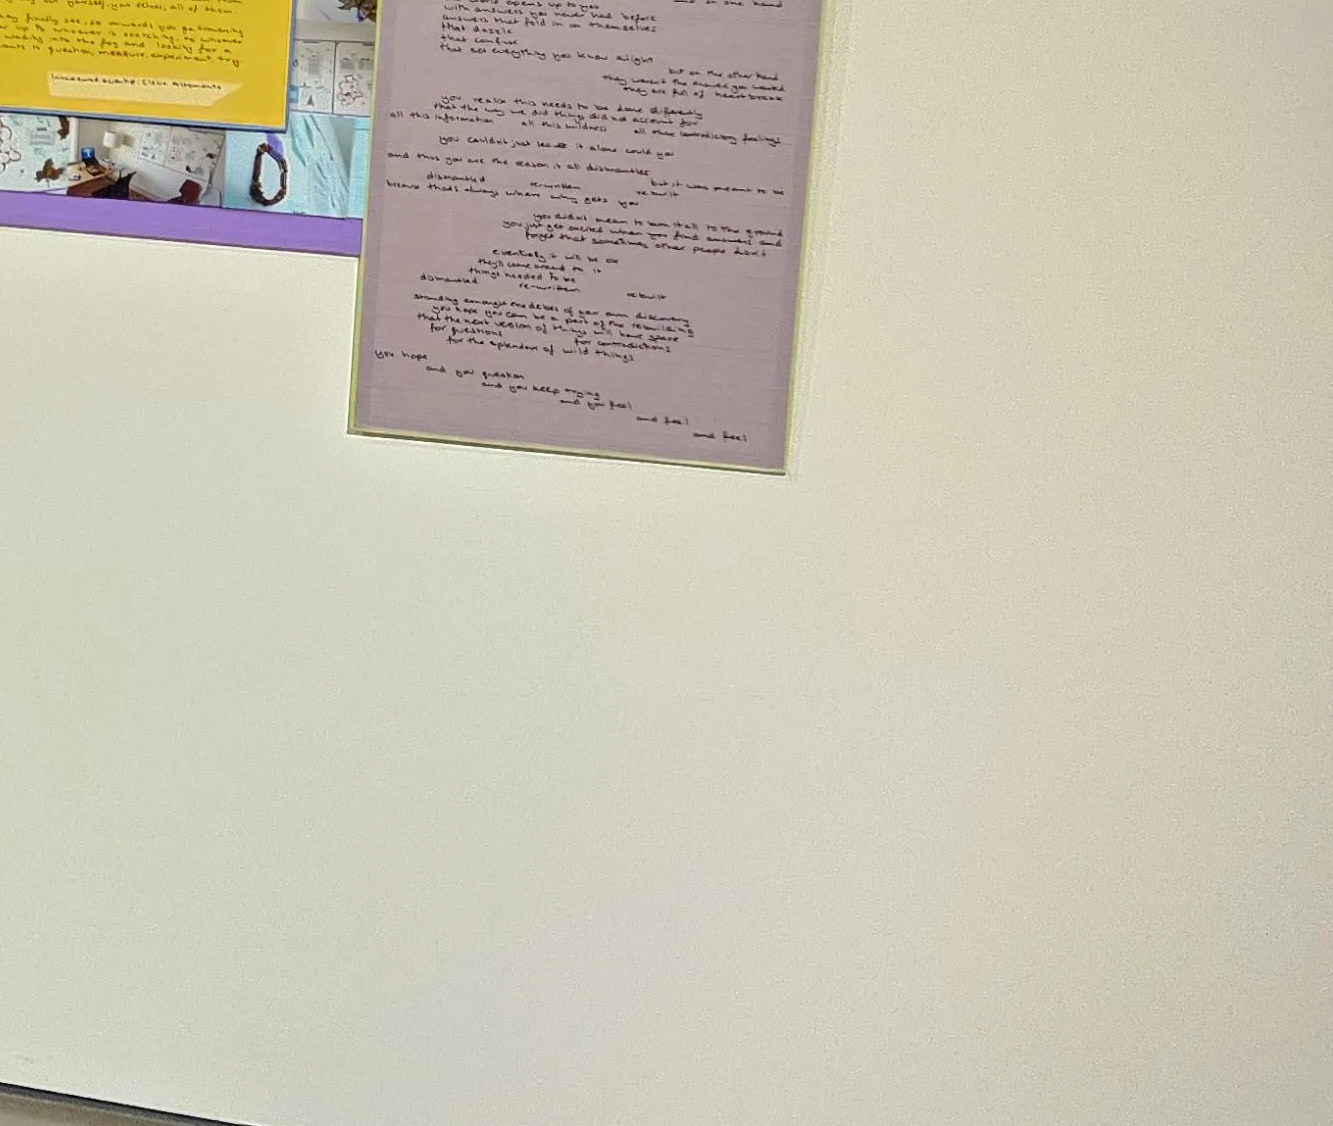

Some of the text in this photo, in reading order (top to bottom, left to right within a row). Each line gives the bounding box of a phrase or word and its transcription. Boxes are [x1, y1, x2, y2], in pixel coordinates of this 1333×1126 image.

[472, 26, 514, 35] dazzle
[374, 349, 429, 362] you hope
[426, 364, 447, 373] and
[455, 369, 475, 378] you
